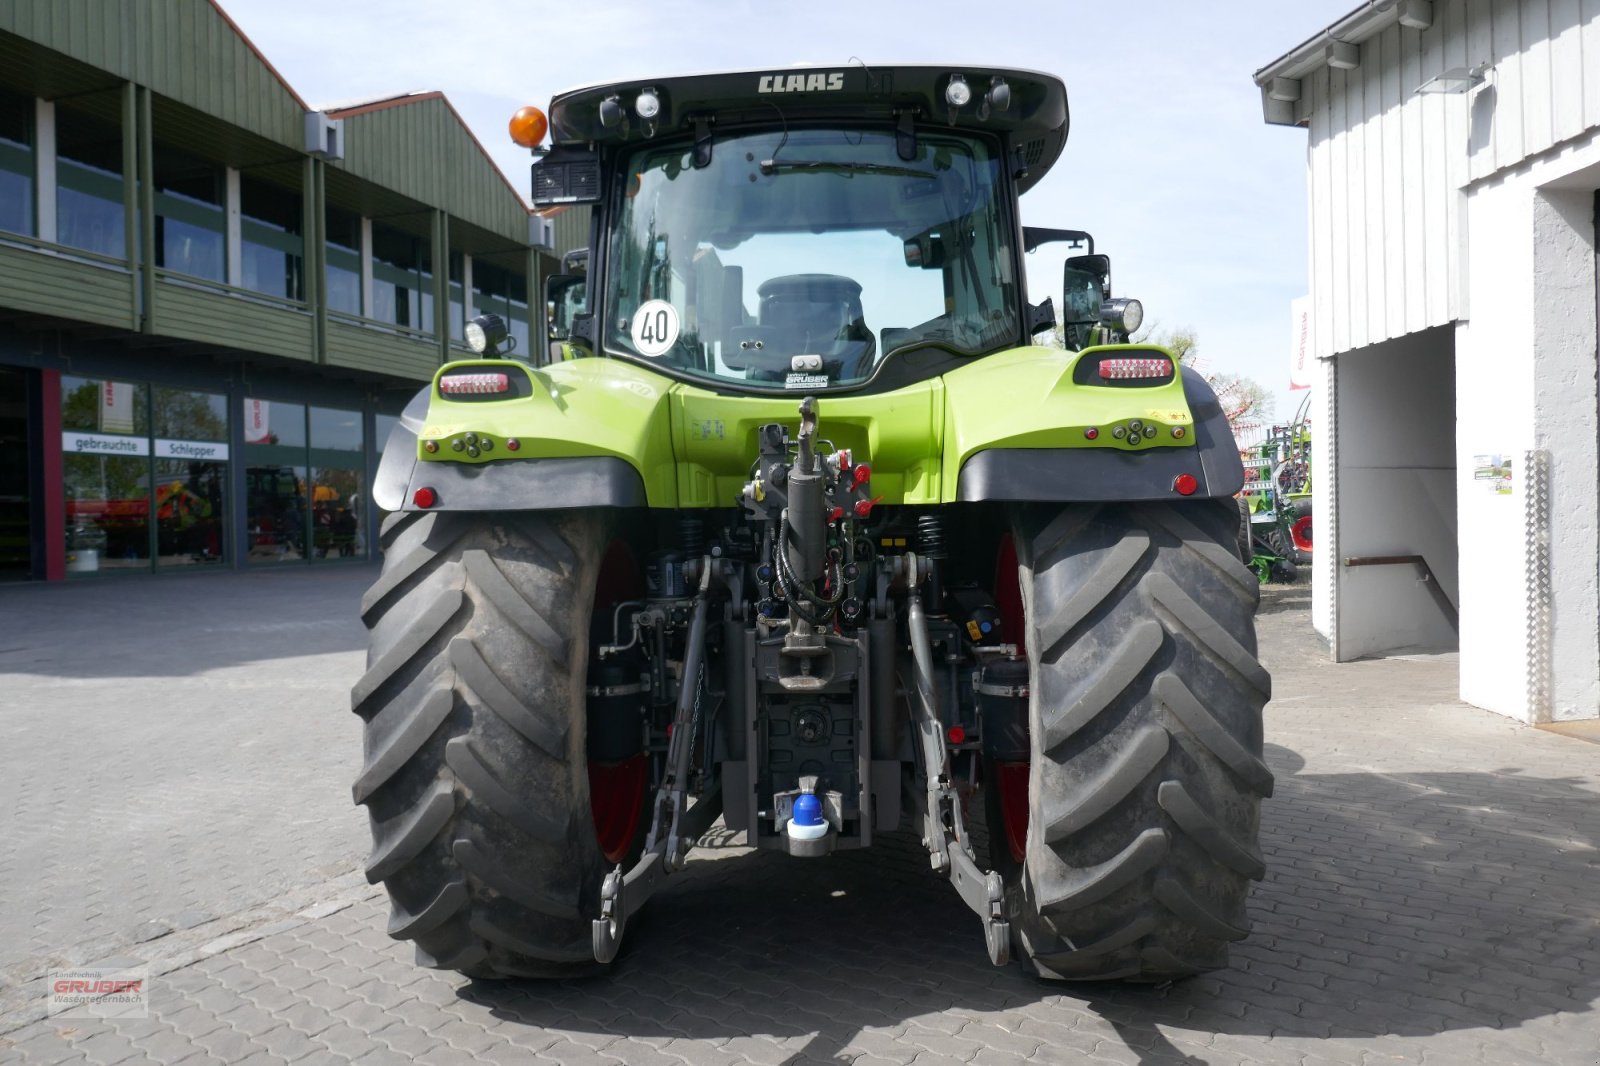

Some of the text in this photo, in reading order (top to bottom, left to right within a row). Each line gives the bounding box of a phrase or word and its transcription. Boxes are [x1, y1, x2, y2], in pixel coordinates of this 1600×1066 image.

[757, 72, 844, 94] CLAAS
[641, 309, 668, 345] 40
[785, 375, 829, 384] GRUBER
[75, 437, 216, 458] gebrauchte Schlepper
